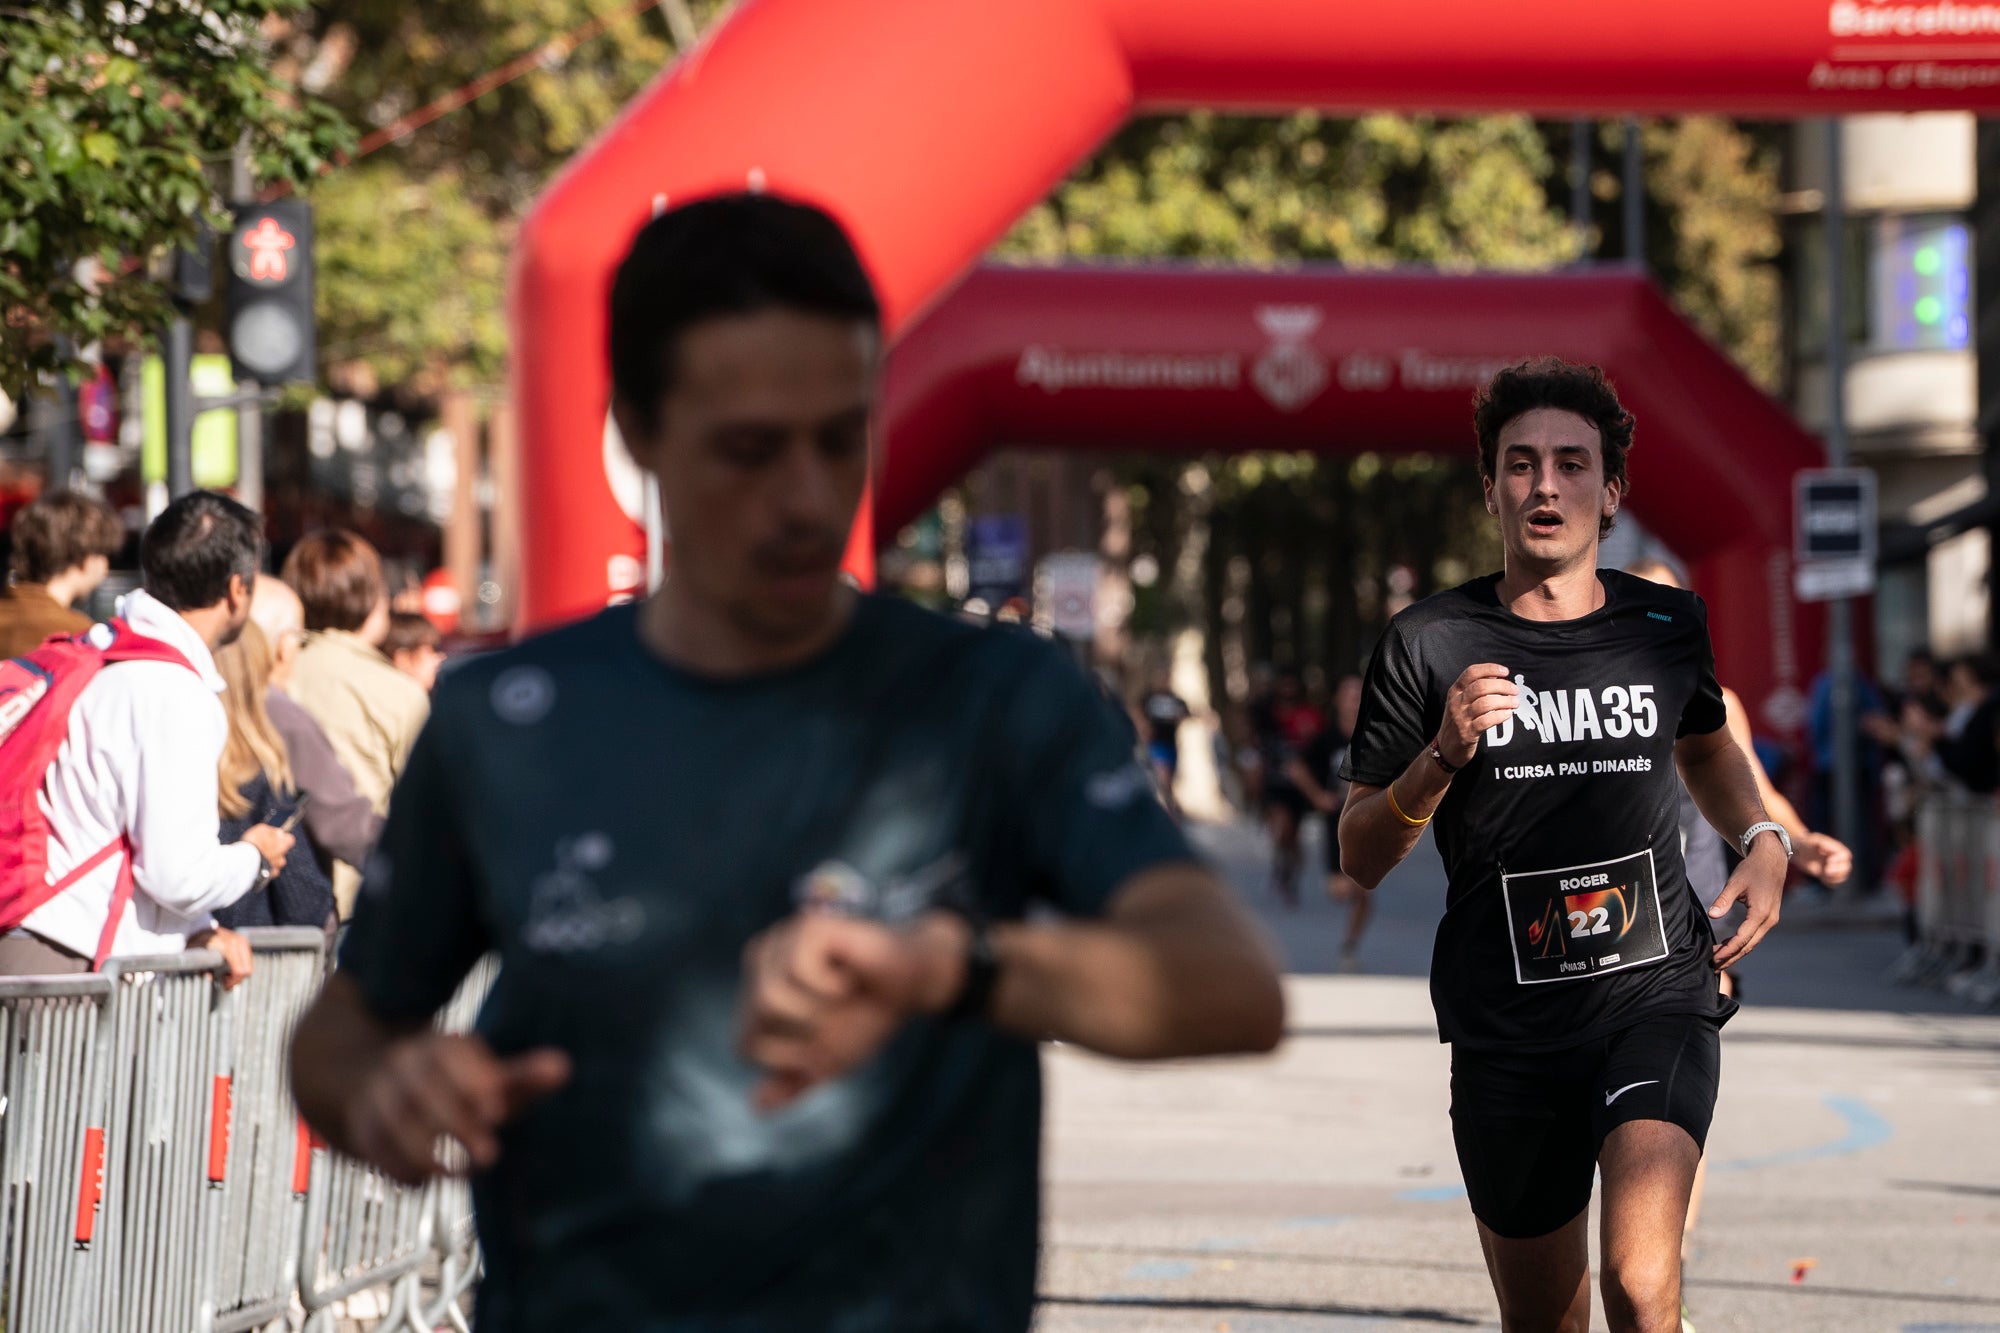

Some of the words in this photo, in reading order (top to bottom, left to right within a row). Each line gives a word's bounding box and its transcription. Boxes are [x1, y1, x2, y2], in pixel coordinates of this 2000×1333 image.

[1829, 0, 2000, 37] Barcelon
[1018, 346, 1239, 393] Ajuntament
[1339, 350, 1392, 391] de
[1402, 347, 1497, 391] Terra
[1494, 767, 1500, 780] I
[1504, 763, 1555, 780] CURSA
[1559, 761, 1588, 776] PAU
[1592, 755, 1653, 774] DINARÈS
[1559, 873, 1610, 891] ROGER
[1567, 906, 1611, 939] 22
